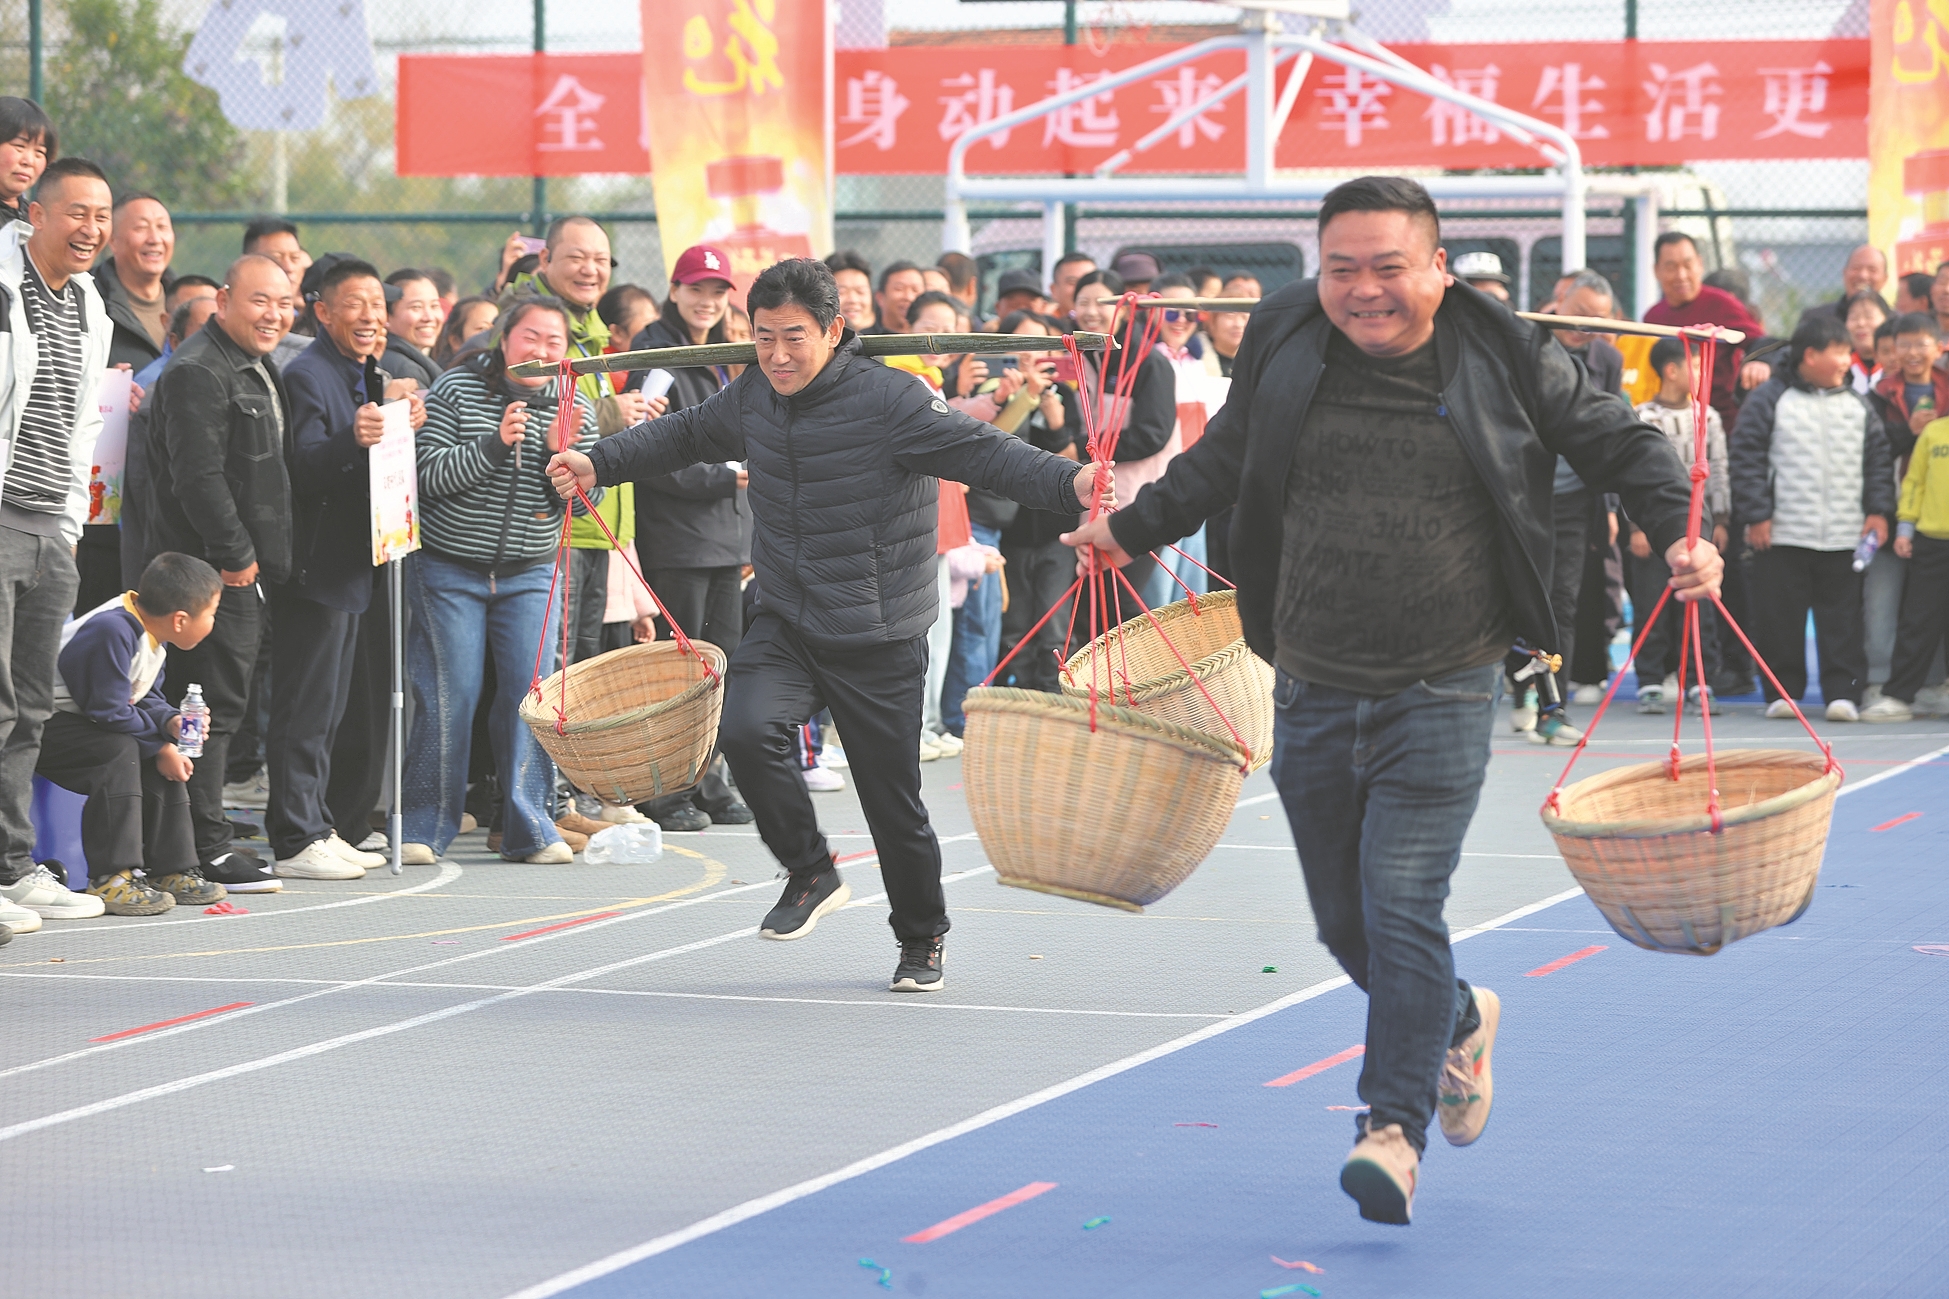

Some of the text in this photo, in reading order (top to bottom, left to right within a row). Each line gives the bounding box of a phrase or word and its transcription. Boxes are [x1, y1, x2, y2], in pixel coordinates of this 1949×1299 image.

[1314, 61, 1870, 147] 幸福生活更
